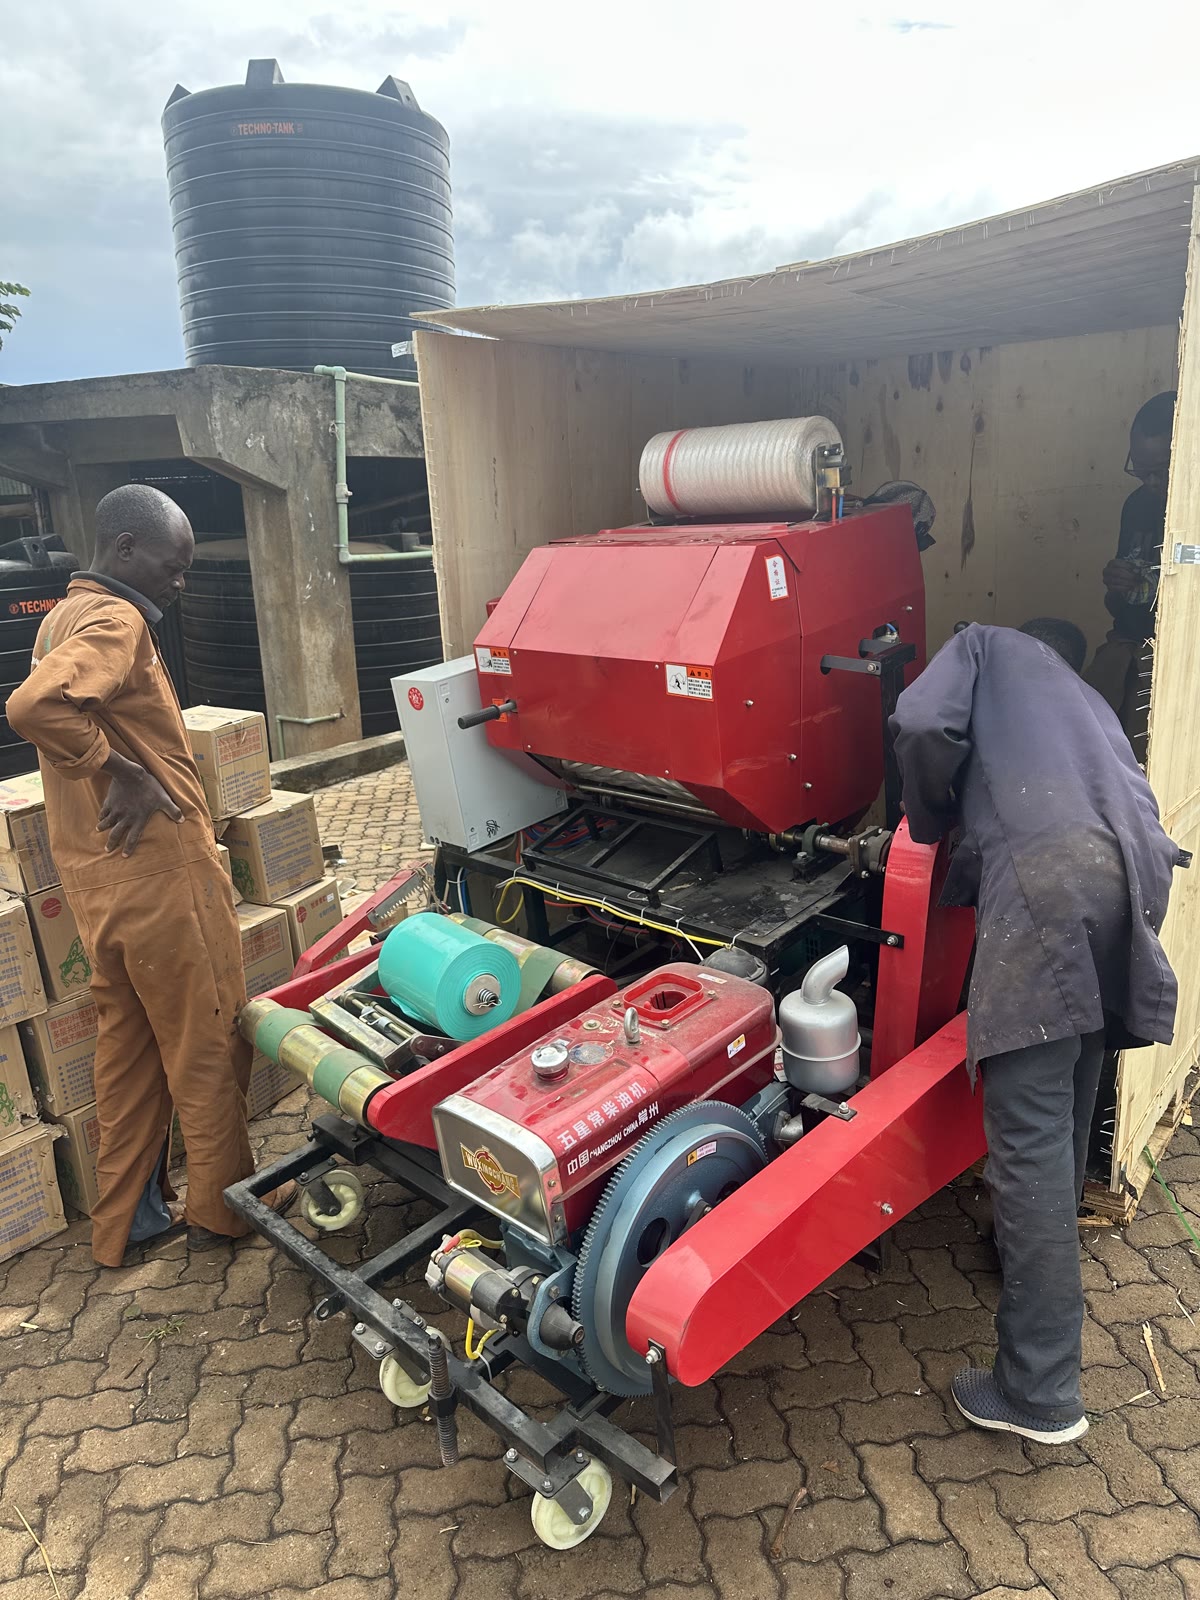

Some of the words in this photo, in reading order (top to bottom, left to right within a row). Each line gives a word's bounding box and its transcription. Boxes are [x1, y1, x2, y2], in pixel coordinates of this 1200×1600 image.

[238, 122, 295, 136] TECHNO-TANK
[557, 1081, 646, 1150] 五星常柴油机
[567, 1149, 589, 1175] 中国
[623, 1122, 639, 1137] CHINA
